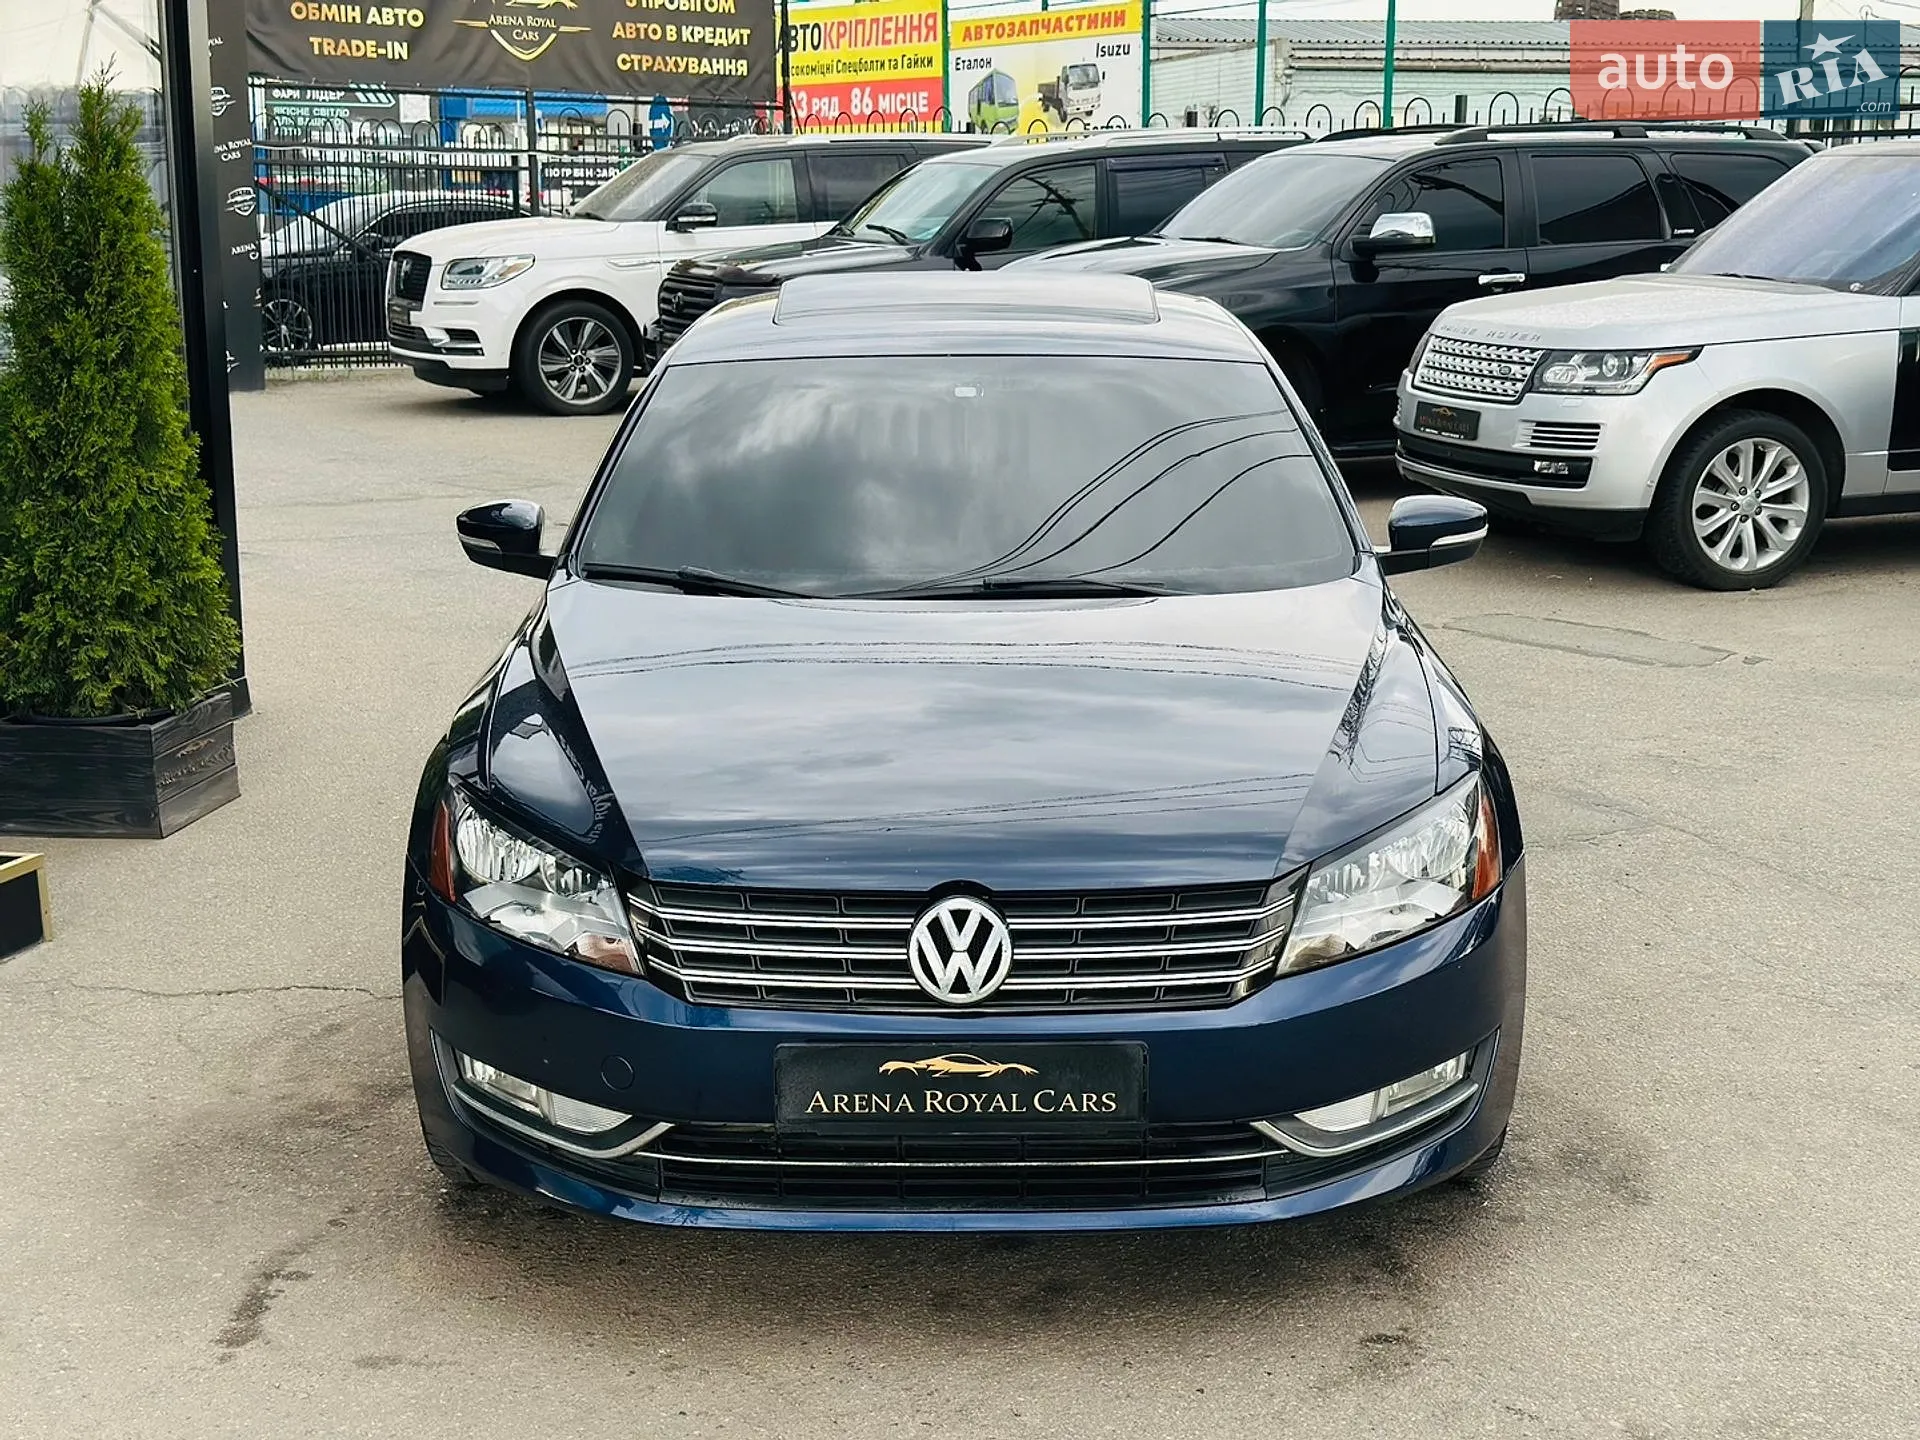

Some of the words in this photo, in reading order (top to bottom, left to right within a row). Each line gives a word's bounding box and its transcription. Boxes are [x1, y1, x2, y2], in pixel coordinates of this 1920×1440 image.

[290, 2, 361, 24] ОБМІН
[366, 7, 424, 28] АВТО
[489, 14, 524, 27] ARENA
[526, 16, 557, 28] ROYAL
[962, 9, 1126, 42] АВТОЗАПЧАСТИНИ
[512, 29, 539, 41] CARS
[612, 22, 662, 41] АВТО
[666, 25, 677, 42] В
[681, 25, 750, 47] КРЕДИТ
[309, 36, 408, 60] TRADE-IN
[1095, 43, 1131, 58] Isuzu
[616, 53, 748, 76] СТРАХУВАННЯ
[836, 57, 885, 76] Спецболти
[888, 57, 898, 71] та
[901, 53, 933, 70] Гайки
[955, 56, 992, 71] Еталон
[272, 88, 300, 99] ФАРИ
[811, 95, 839, 120] РЯД
[850, 87, 872, 116] 86
[878, 91, 929, 119] МІСЦЕ
[805, 1090, 914, 1114] ARENA
[924, 1090, 1027, 1114] ROYAL
[1033, 1089, 1117, 1113] CARS
